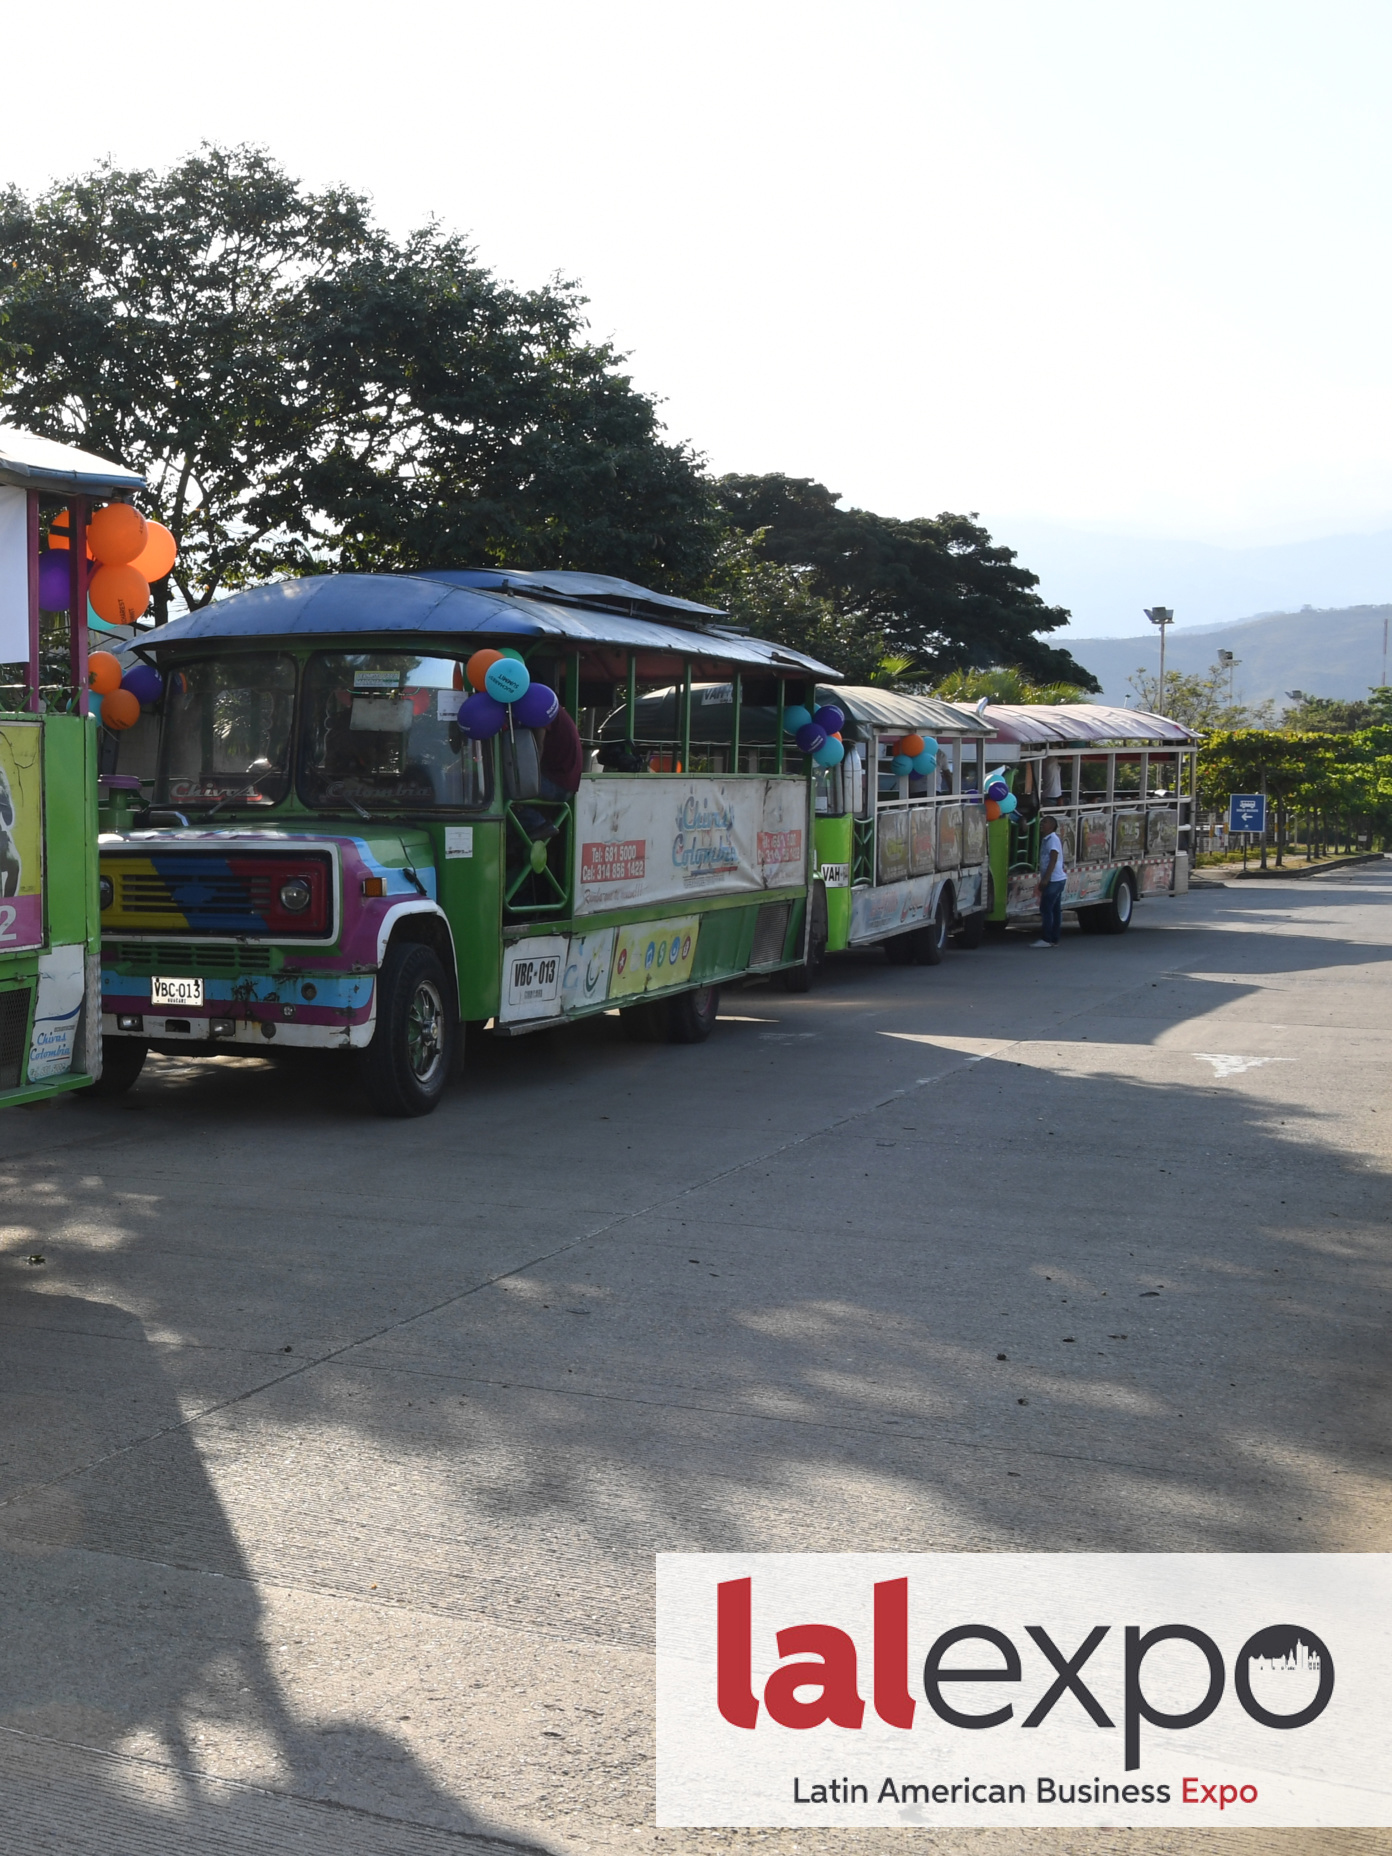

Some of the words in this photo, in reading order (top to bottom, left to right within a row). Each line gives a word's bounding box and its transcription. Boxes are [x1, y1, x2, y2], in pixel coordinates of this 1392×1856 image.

[514, 960, 556, 987] VBC-013
[154, 981, 200, 999] VBC-013
[36, 1031, 67, 1046] Chivas
[29, 1043, 71, 1061] Colombia
